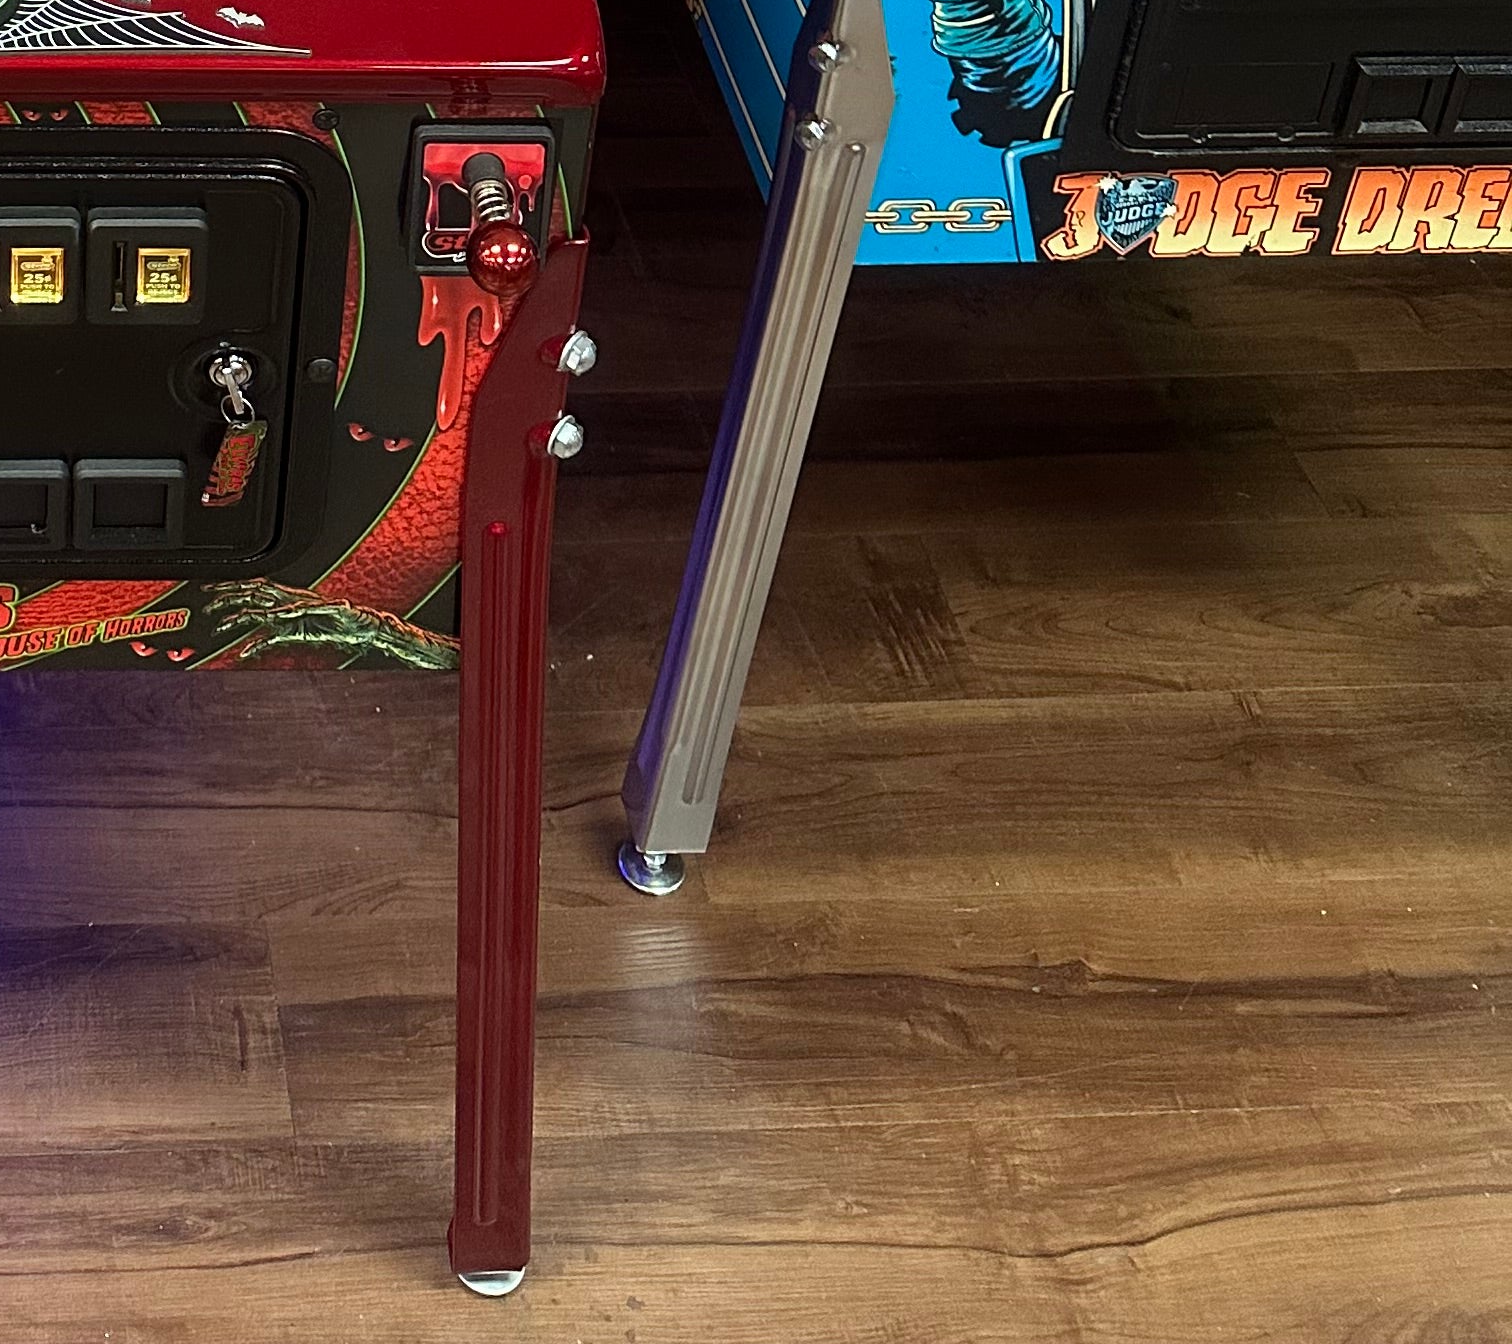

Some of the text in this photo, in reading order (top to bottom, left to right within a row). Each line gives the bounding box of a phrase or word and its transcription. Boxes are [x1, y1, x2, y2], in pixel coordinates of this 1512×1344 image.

[1044, 169, 1331, 257] JDGE
[1101, 201, 1164, 226] JUDGE
[23, 273, 51, 284] 25¢
[149, 273, 178, 284] 25¢
[67, 620, 98, 646] OF
[102, 610, 189, 641] HORRORS
